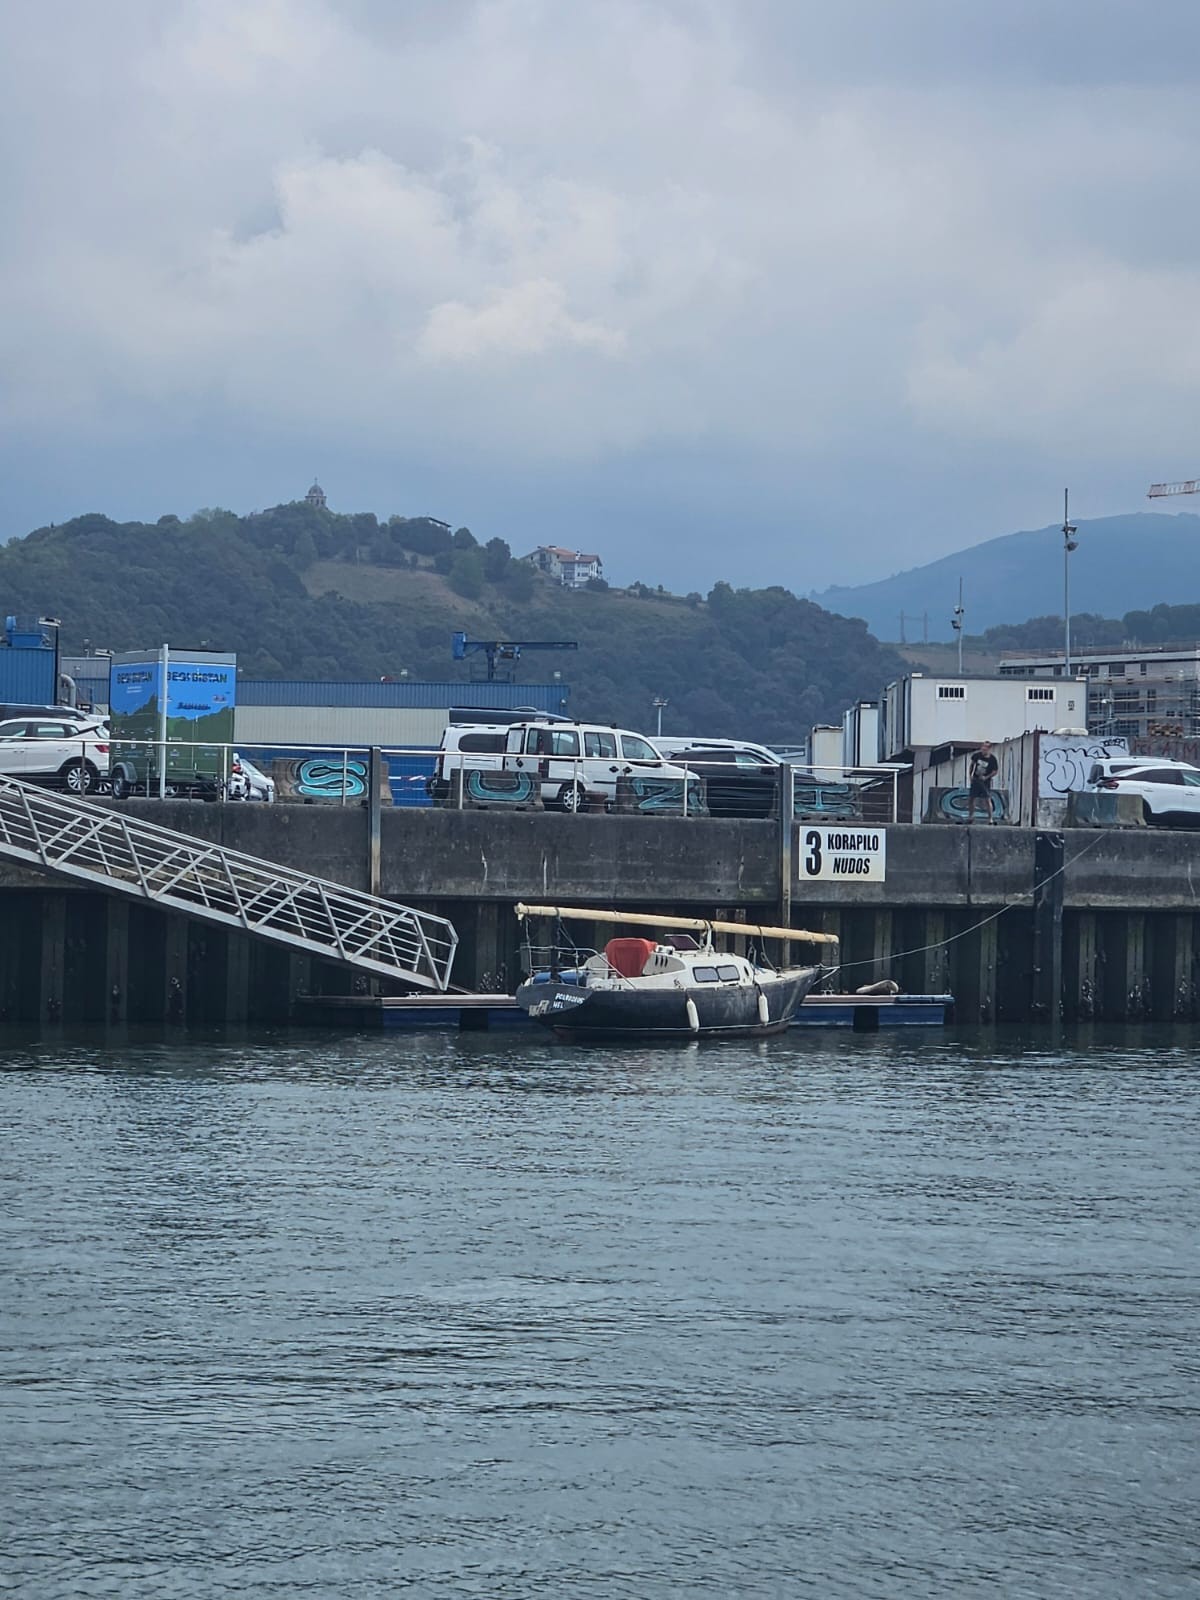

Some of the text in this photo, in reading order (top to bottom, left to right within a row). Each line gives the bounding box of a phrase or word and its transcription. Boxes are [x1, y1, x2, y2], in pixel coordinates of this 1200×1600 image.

[827, 833, 879, 851] KORAPILO
[806, 831, 821, 876] 3
[833, 857, 871, 875] NUDOS
